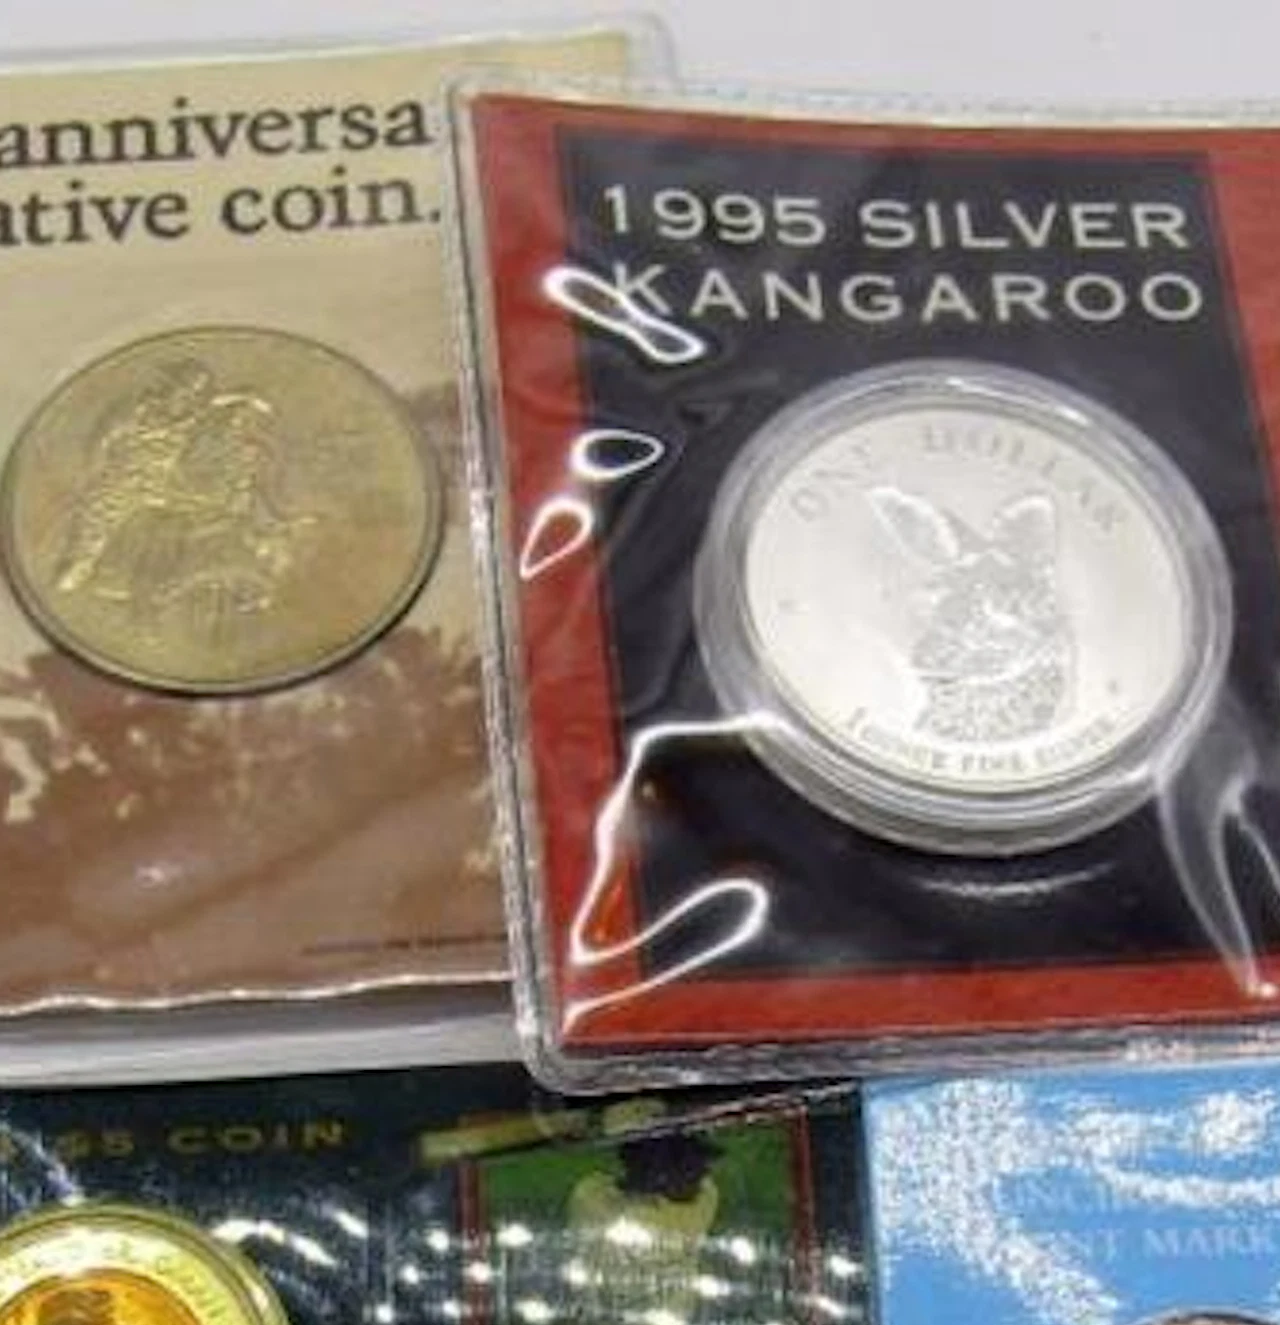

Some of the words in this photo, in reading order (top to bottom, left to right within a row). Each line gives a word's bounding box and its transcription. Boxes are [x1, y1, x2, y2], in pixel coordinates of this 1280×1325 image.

[220, 165, 441, 235] coin.
[603, 184, 826, 246] 1995
[860, 198, 1190, 250] SILVER
[614, 263, 1203, 322] KANGAROO
[168, 1122, 344, 1153] COIN
